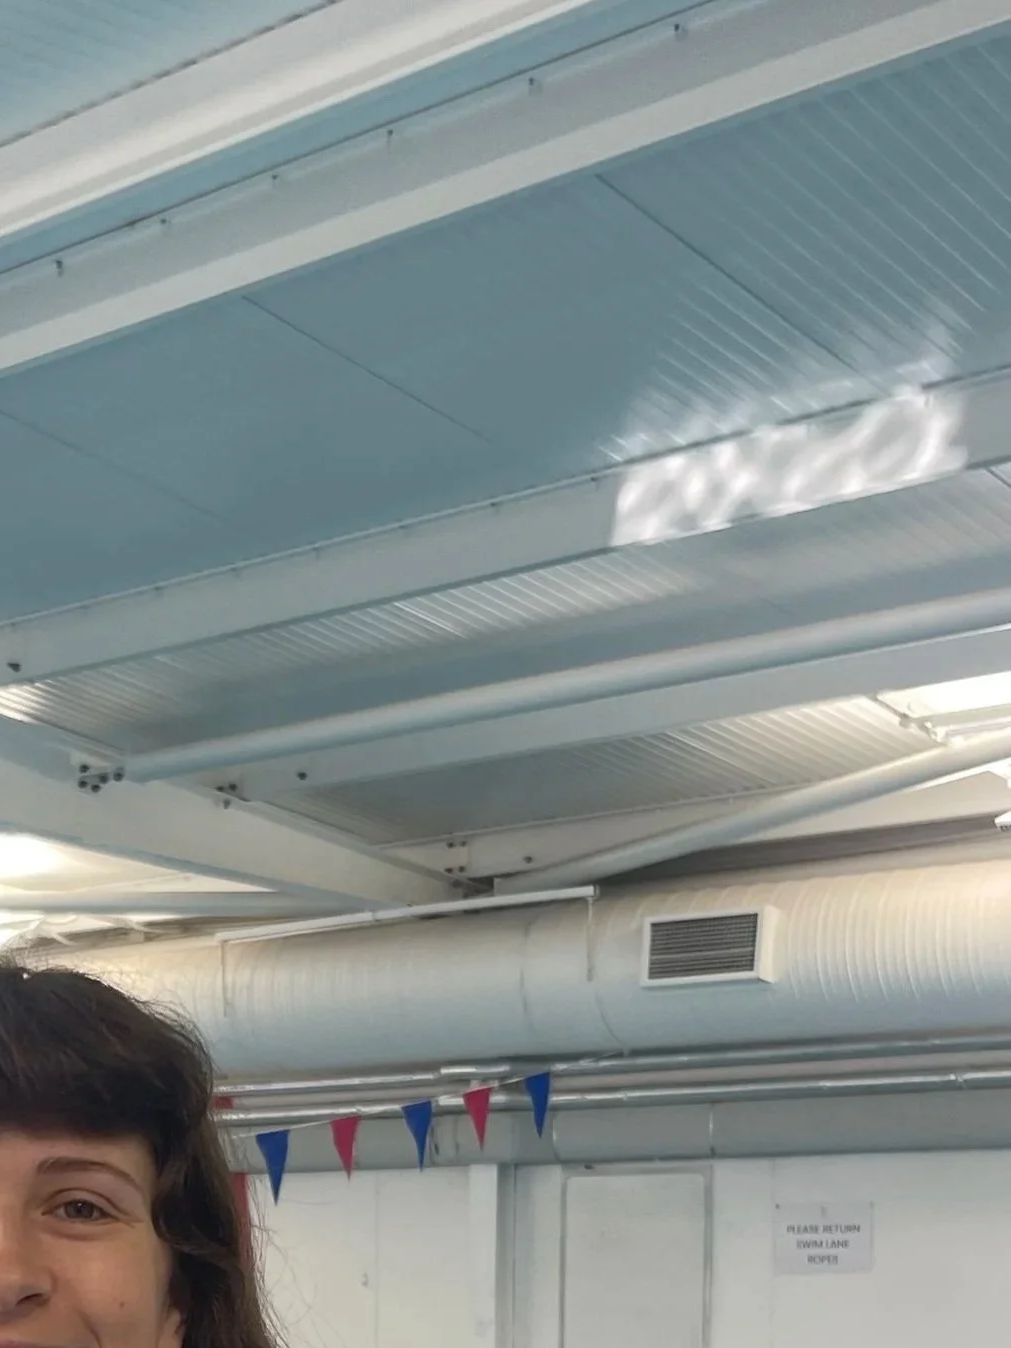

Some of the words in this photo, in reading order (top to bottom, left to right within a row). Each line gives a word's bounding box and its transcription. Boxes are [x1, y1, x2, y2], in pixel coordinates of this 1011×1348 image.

[786, 1224, 819, 1235] PLEASE
[822, 1224, 861, 1234] RETURN
[796, 1239, 823, 1249] SWIM
[825, 1239, 850, 1249] LANE
